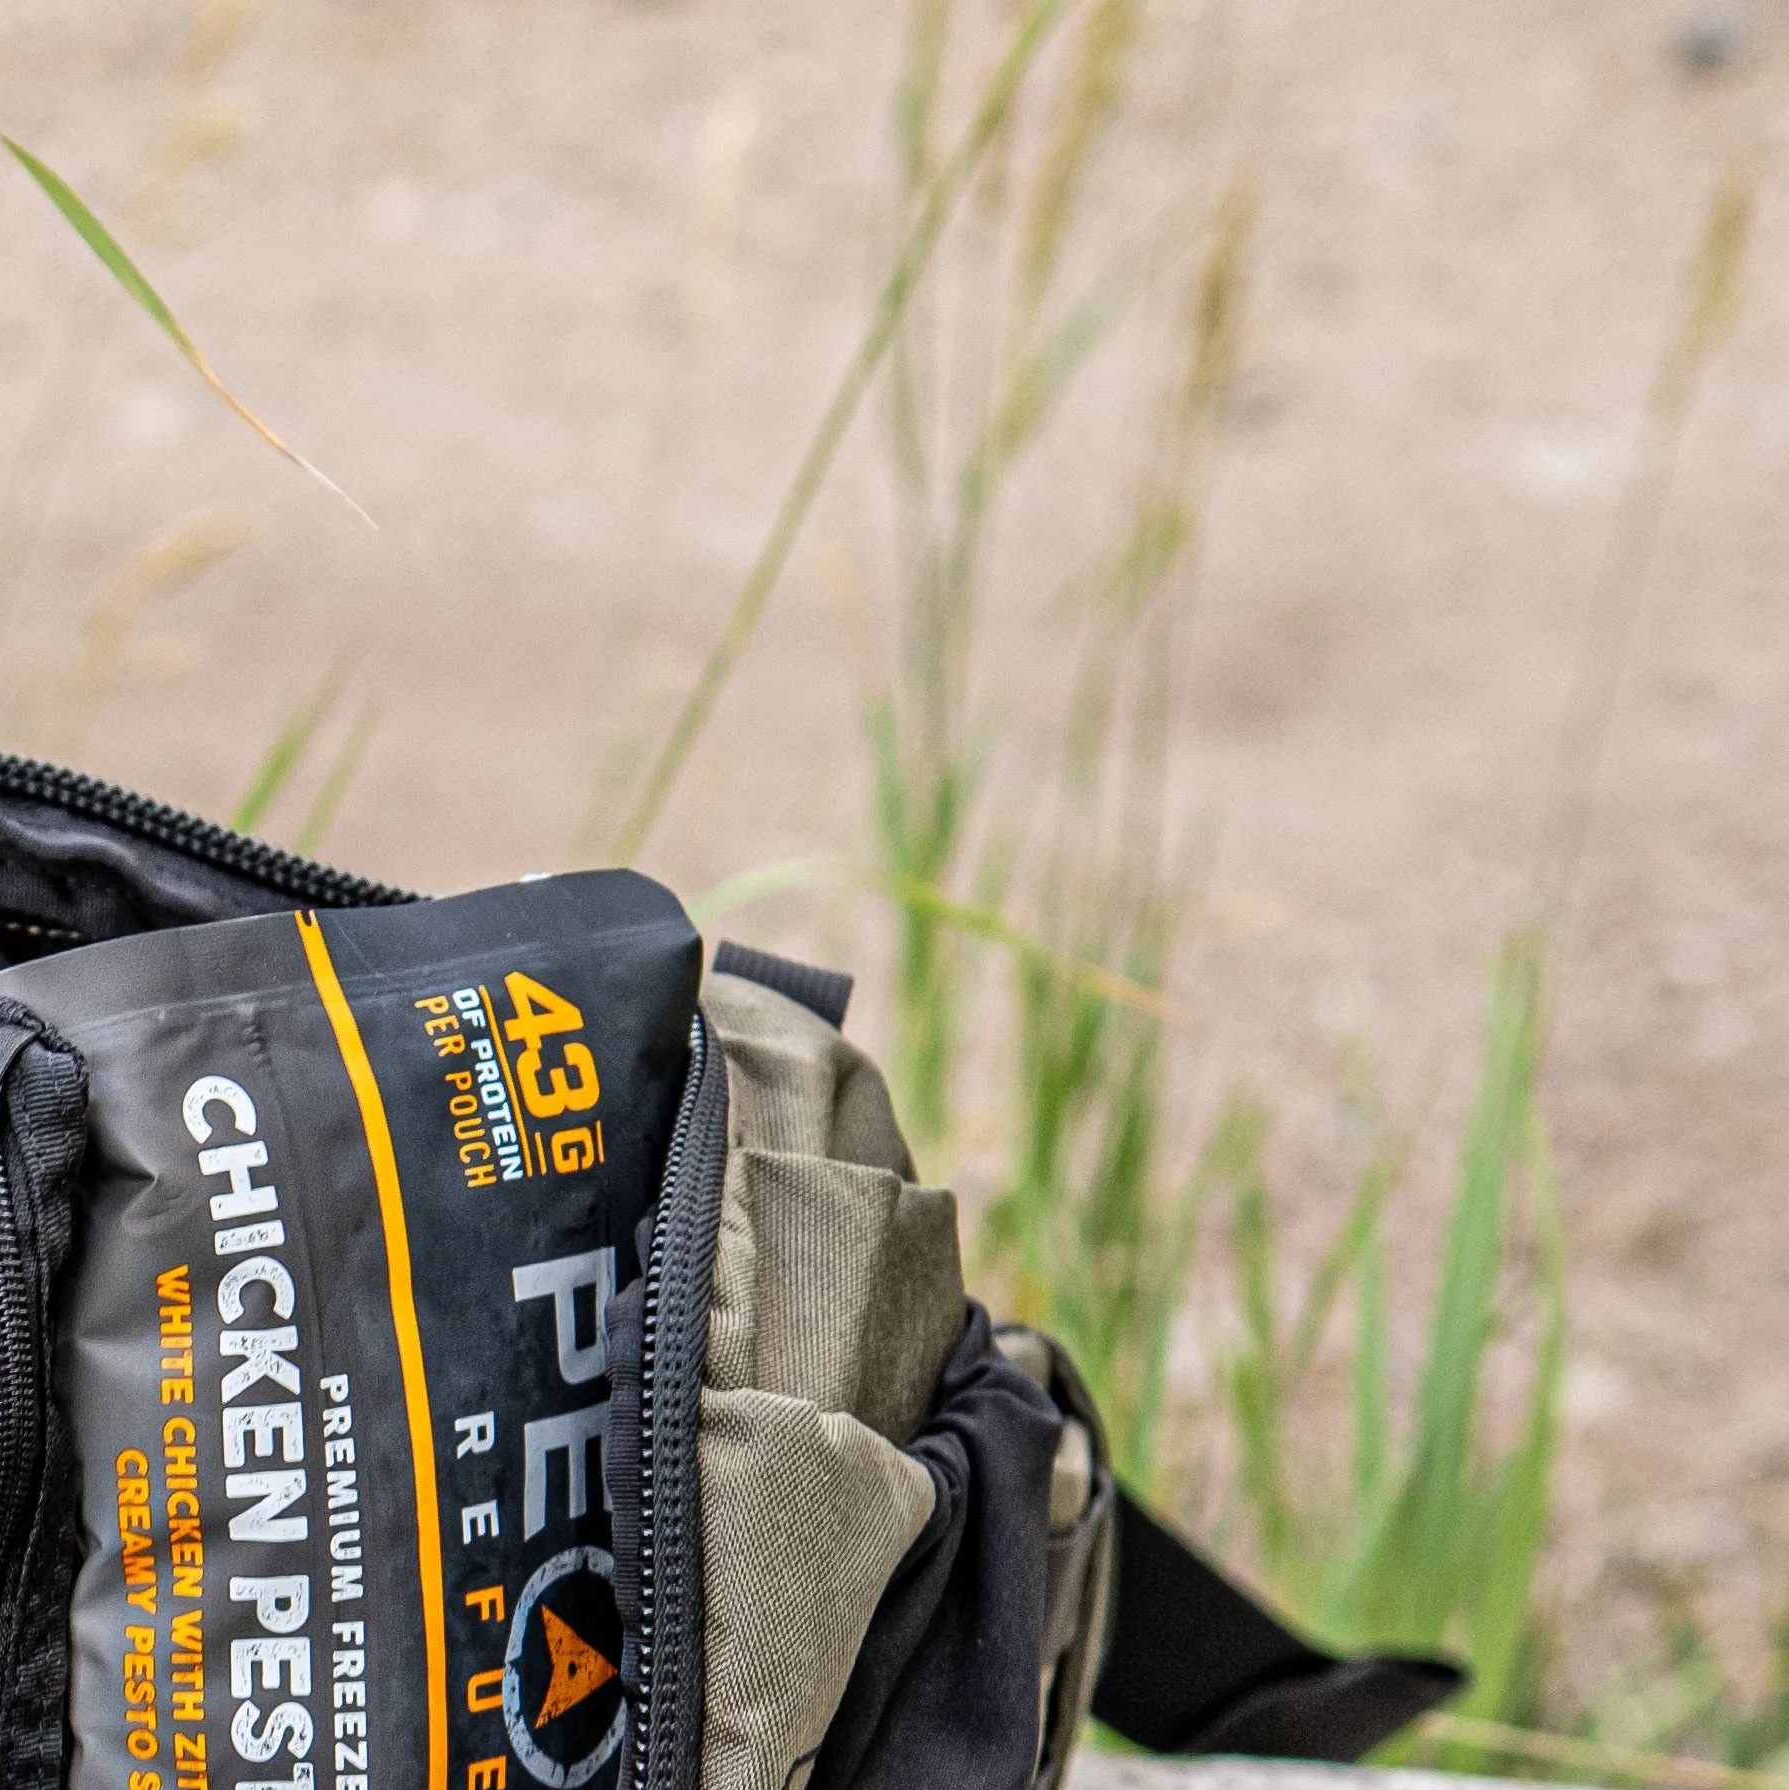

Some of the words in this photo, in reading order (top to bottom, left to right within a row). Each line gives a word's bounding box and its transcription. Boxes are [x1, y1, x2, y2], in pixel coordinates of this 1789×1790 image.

[414, 995, 466, 1057] PER
[444, 1070, 498, 1188] POUCH
[452, 987, 486, 1029] OF
[471, 1038, 524, 1182] PROTEIN
[156, 1264, 196, 1405] WHITE
[182, 1075, 308, 1543] CHICKEN
[115, 1448, 157, 1616] CREAMY
[162, 1416, 204, 1599] CHICKEN
[319, 1373, 365, 1604] PREMIUM
[123, 1626, 159, 1761] PESTO
[169, 1609, 206, 1721] WITH
